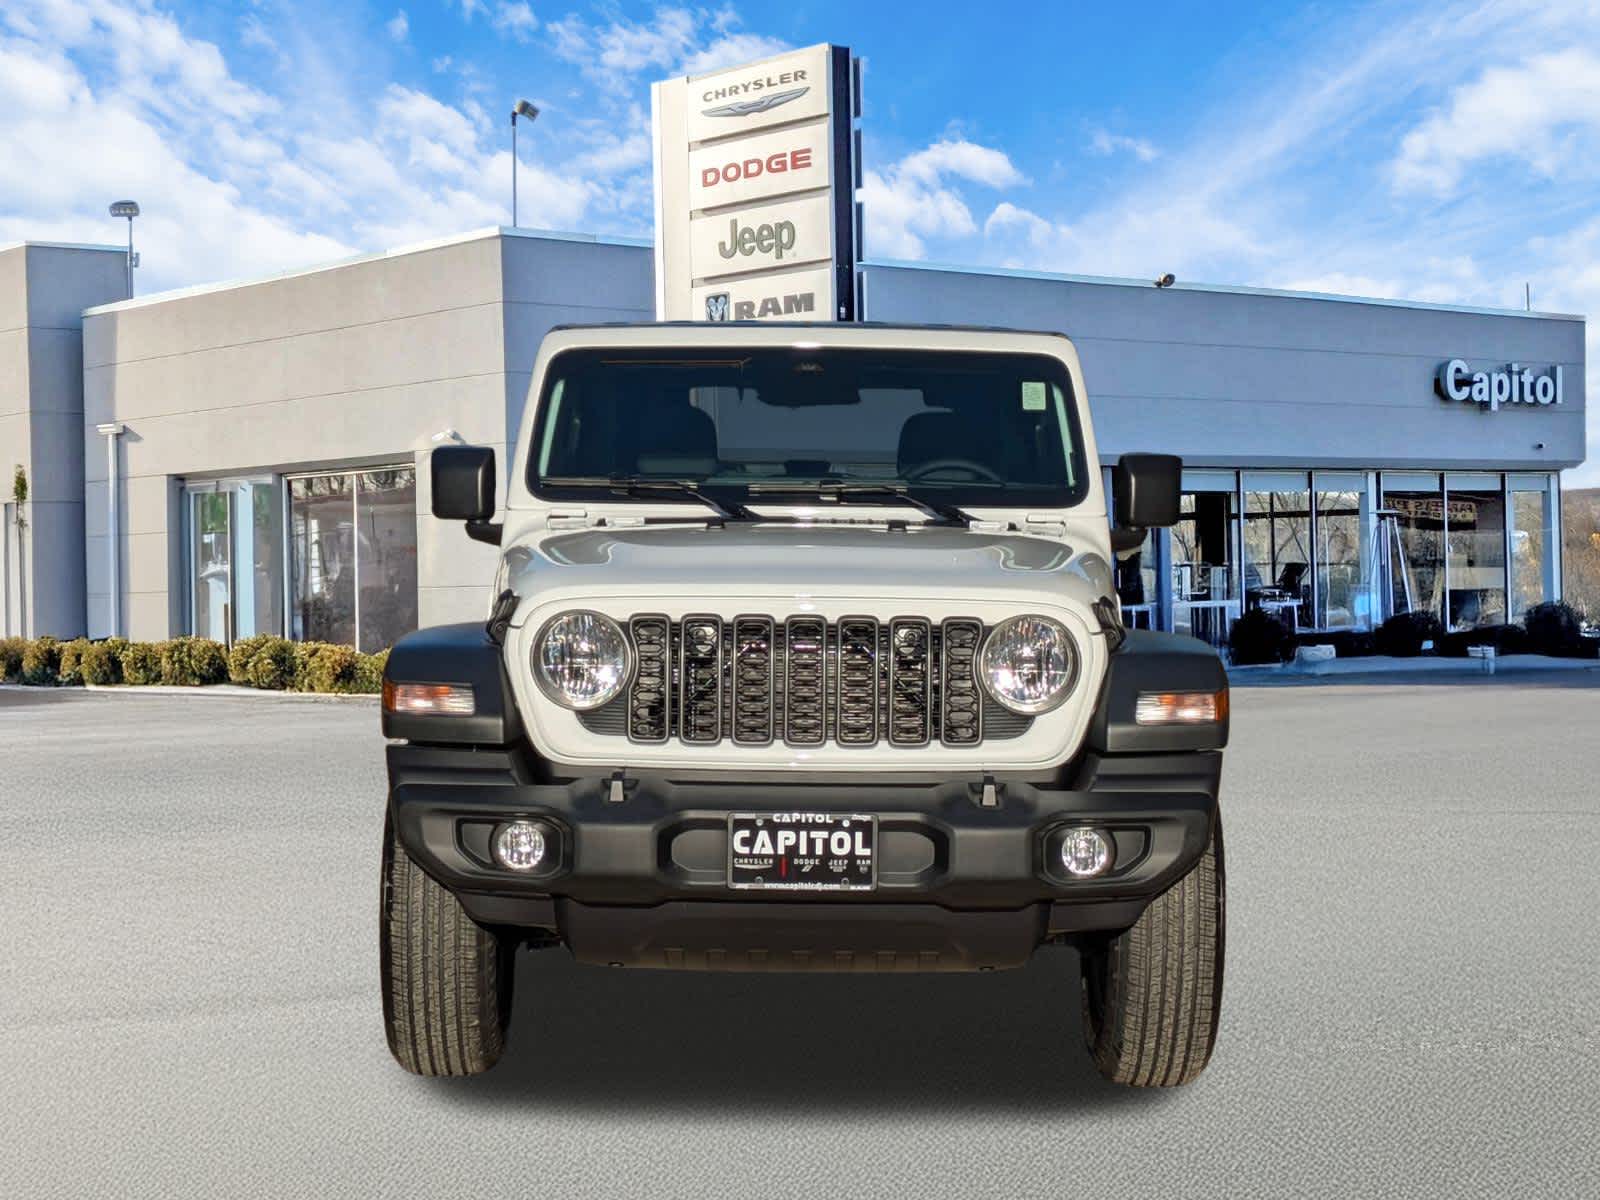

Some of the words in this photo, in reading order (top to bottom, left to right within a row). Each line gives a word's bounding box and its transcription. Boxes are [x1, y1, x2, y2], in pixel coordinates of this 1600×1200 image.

[702, 70, 808, 103] CHRYSLER
[702, 147, 812, 188] DODGE
[718, 218, 796, 260] Jeep
[734, 292, 815, 320] RAM
[1446, 359, 1563, 412] Capitol
[772, 813, 834, 824] CAPITOL
[733, 829, 872, 856] CAPITOL
[734, 857, 774, 865] CHRYSLER
